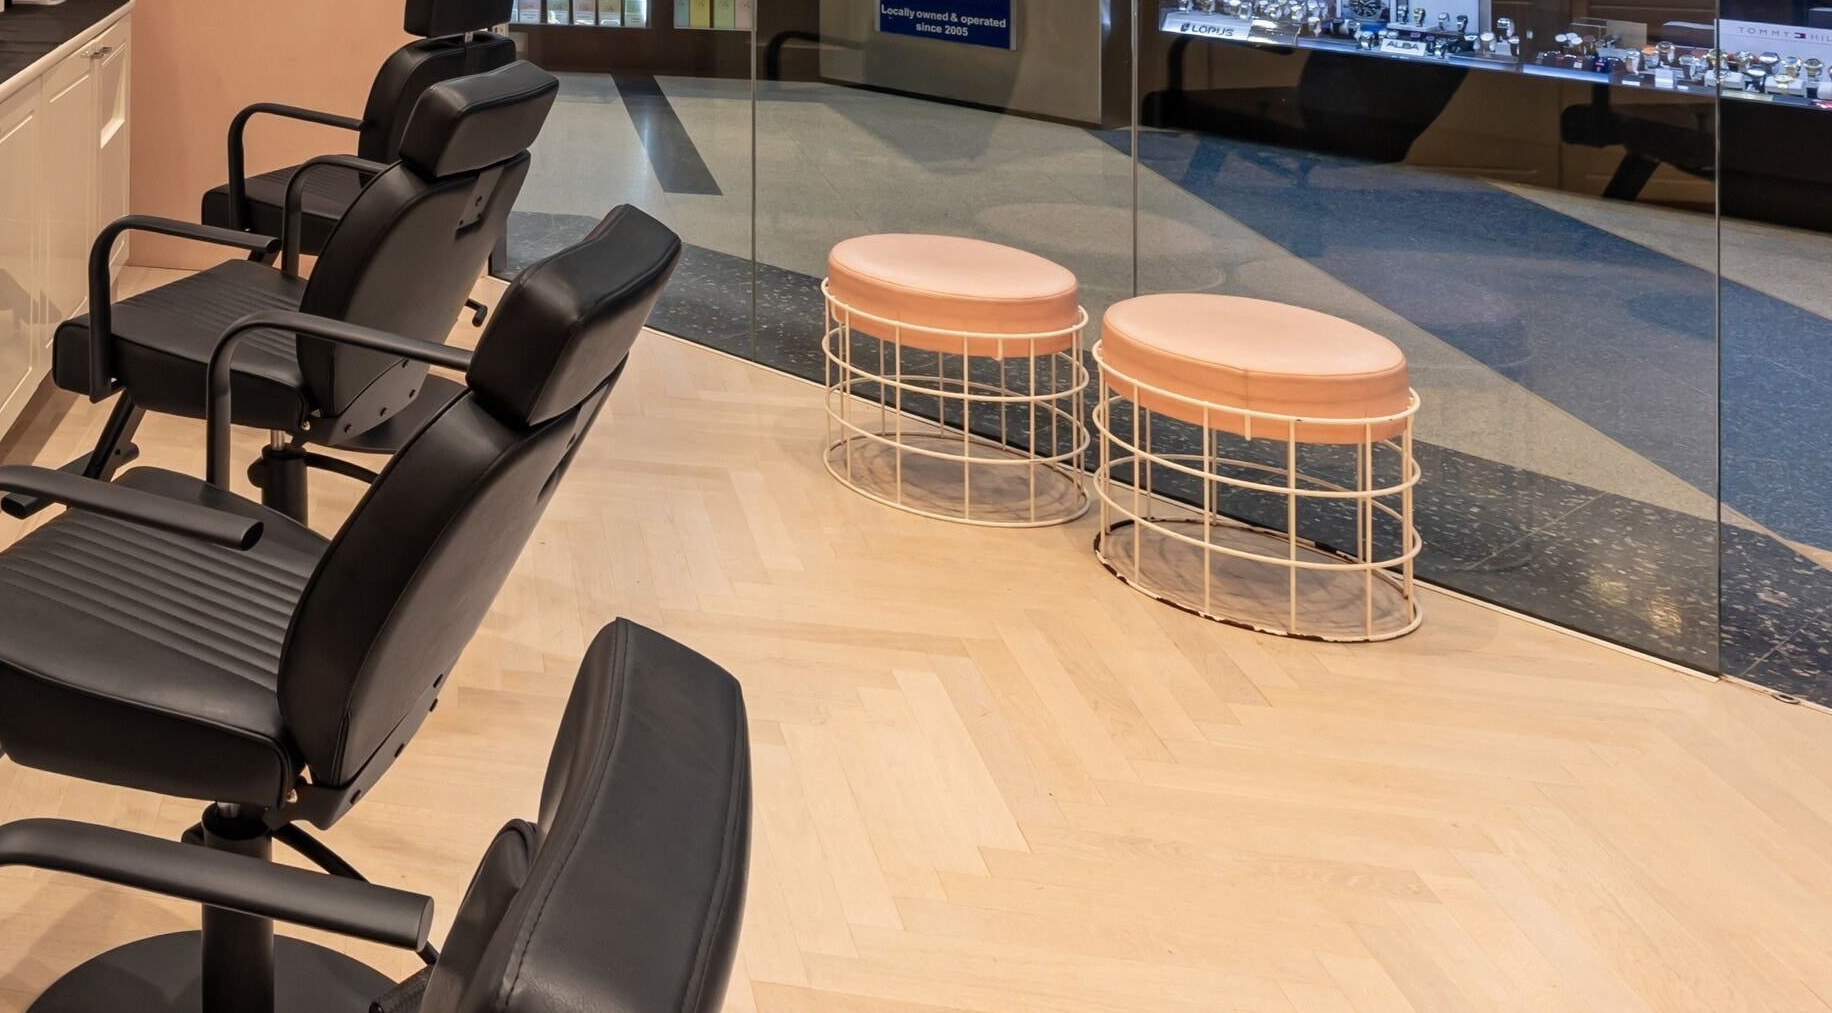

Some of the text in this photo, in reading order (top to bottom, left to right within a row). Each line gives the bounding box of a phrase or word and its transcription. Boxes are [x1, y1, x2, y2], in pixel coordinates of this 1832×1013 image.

[881, 5, 1006, 28] Locally owned & operated
[916, 23, 968, 36] since 2005
[1739, 26, 1790, 38] TOMMY
